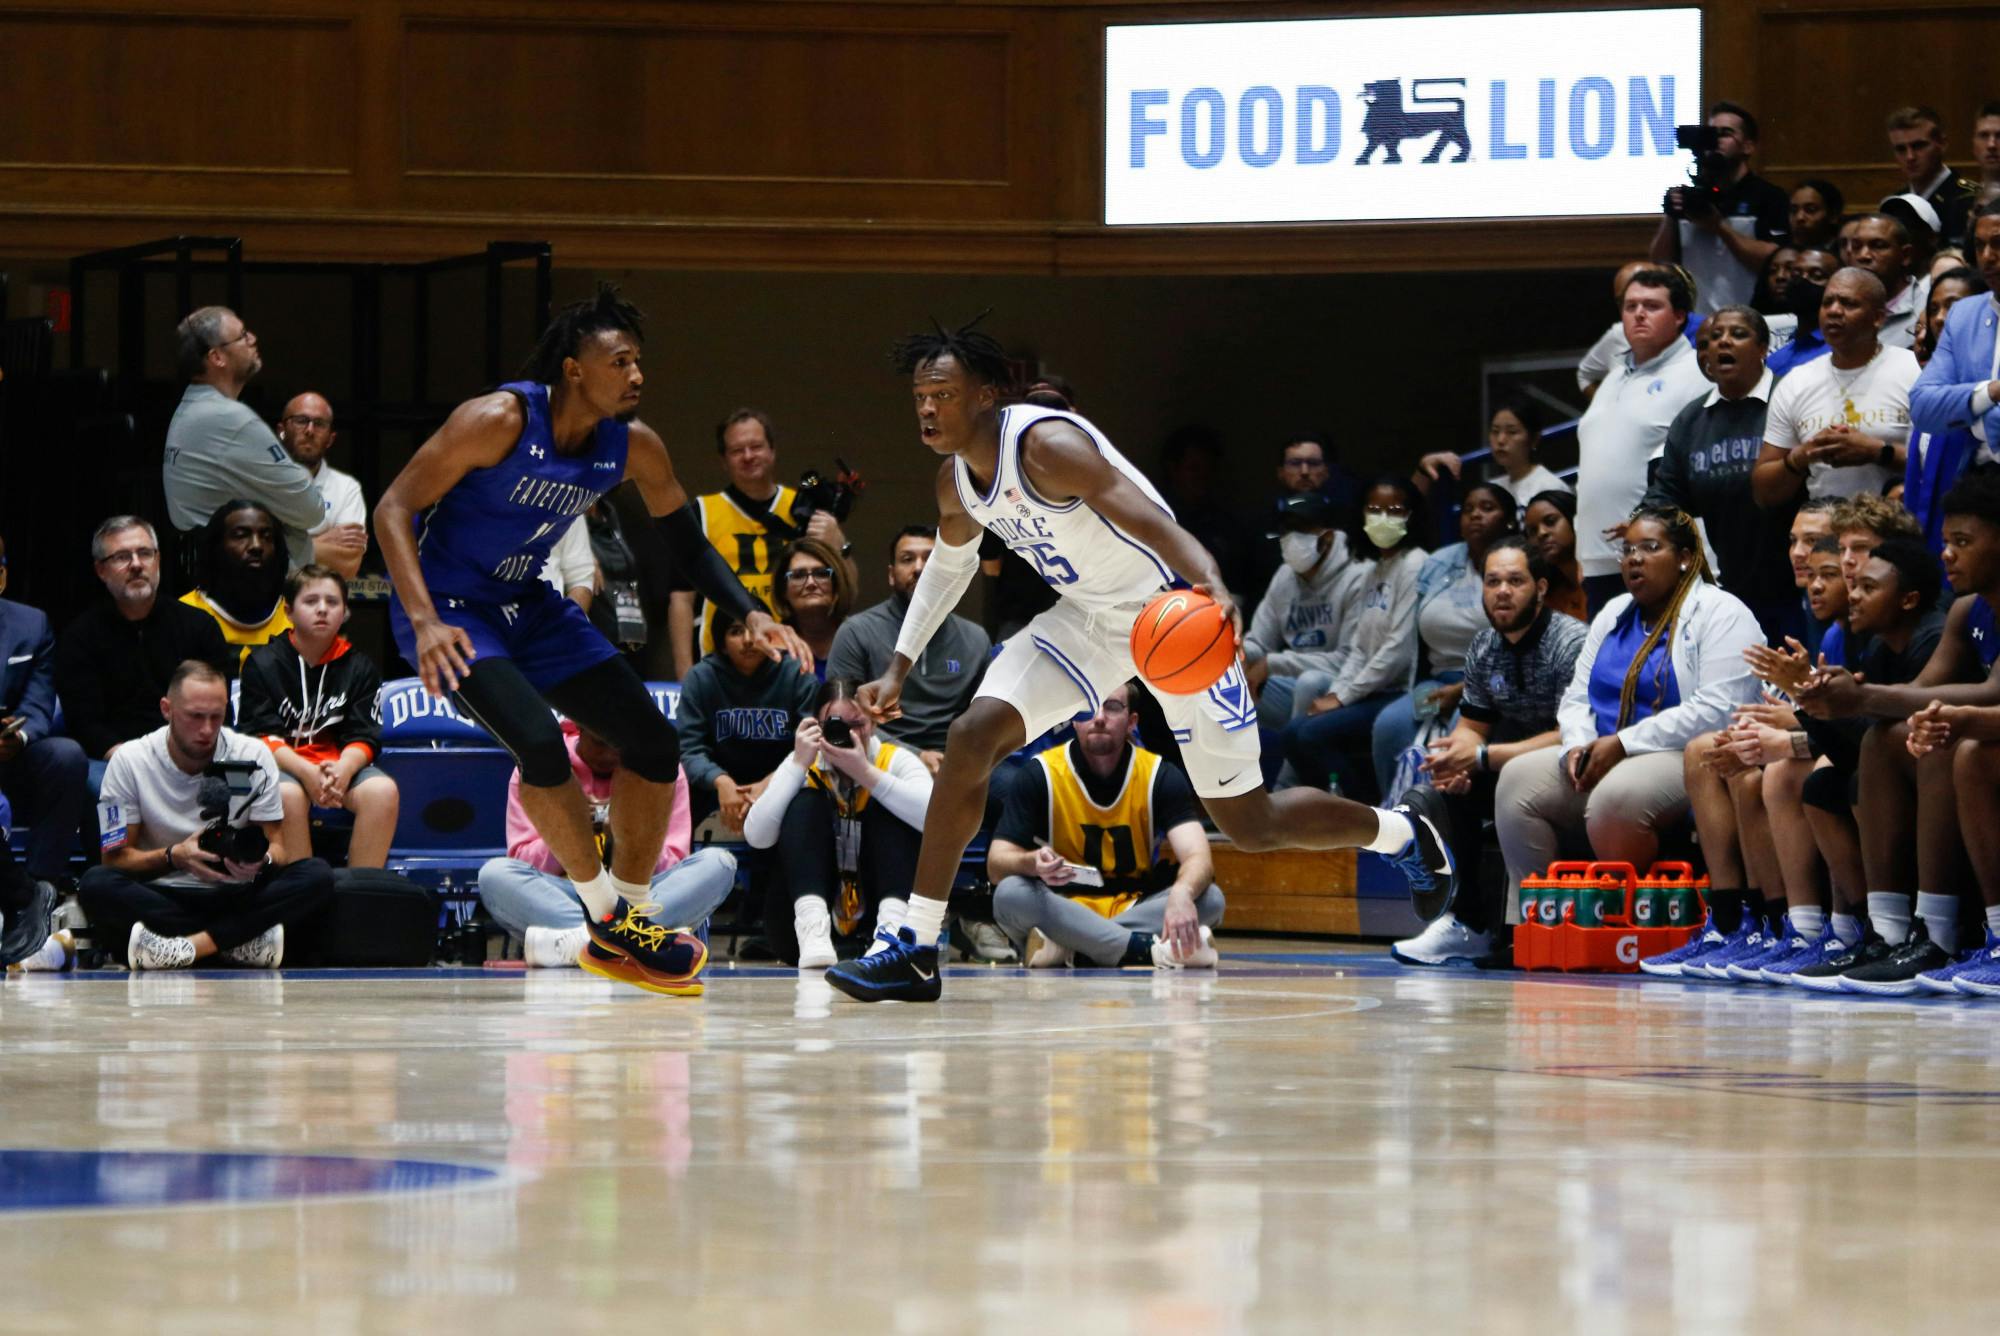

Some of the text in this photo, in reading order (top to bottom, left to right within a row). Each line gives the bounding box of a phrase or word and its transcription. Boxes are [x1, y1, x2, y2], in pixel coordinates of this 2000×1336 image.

[1129, 74, 1677, 169] FOOD LION
[593, 461, 617, 470] CIAA
[987, 516, 1055, 545] DUKE
[389, 686, 475, 728] DUK
[715, 707, 790, 742] DUKE
[1540, 899, 1557, 921] G
[1635, 898, 1652, 920] G
[1668, 899, 1680, 920] G
[1616, 935, 1639, 964] G
